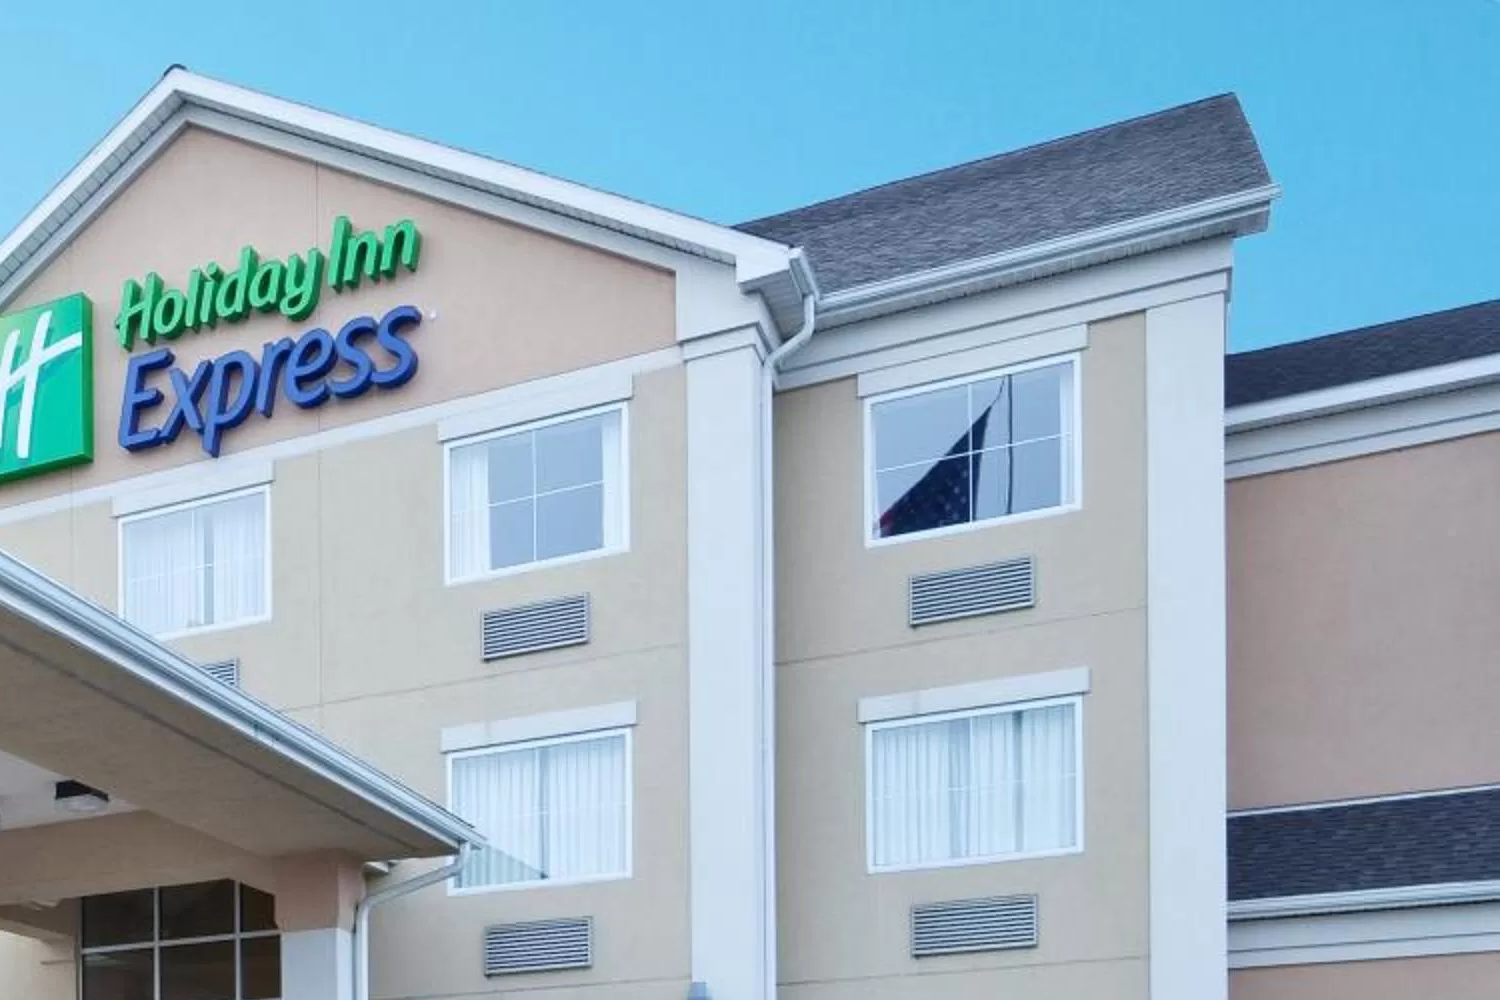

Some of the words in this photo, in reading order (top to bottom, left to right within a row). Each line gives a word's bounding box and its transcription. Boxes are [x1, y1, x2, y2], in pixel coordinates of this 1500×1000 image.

[116, 246, 325, 349] Holiday
[328, 216, 421, 291] Inn
[118, 305, 421, 457] Express
